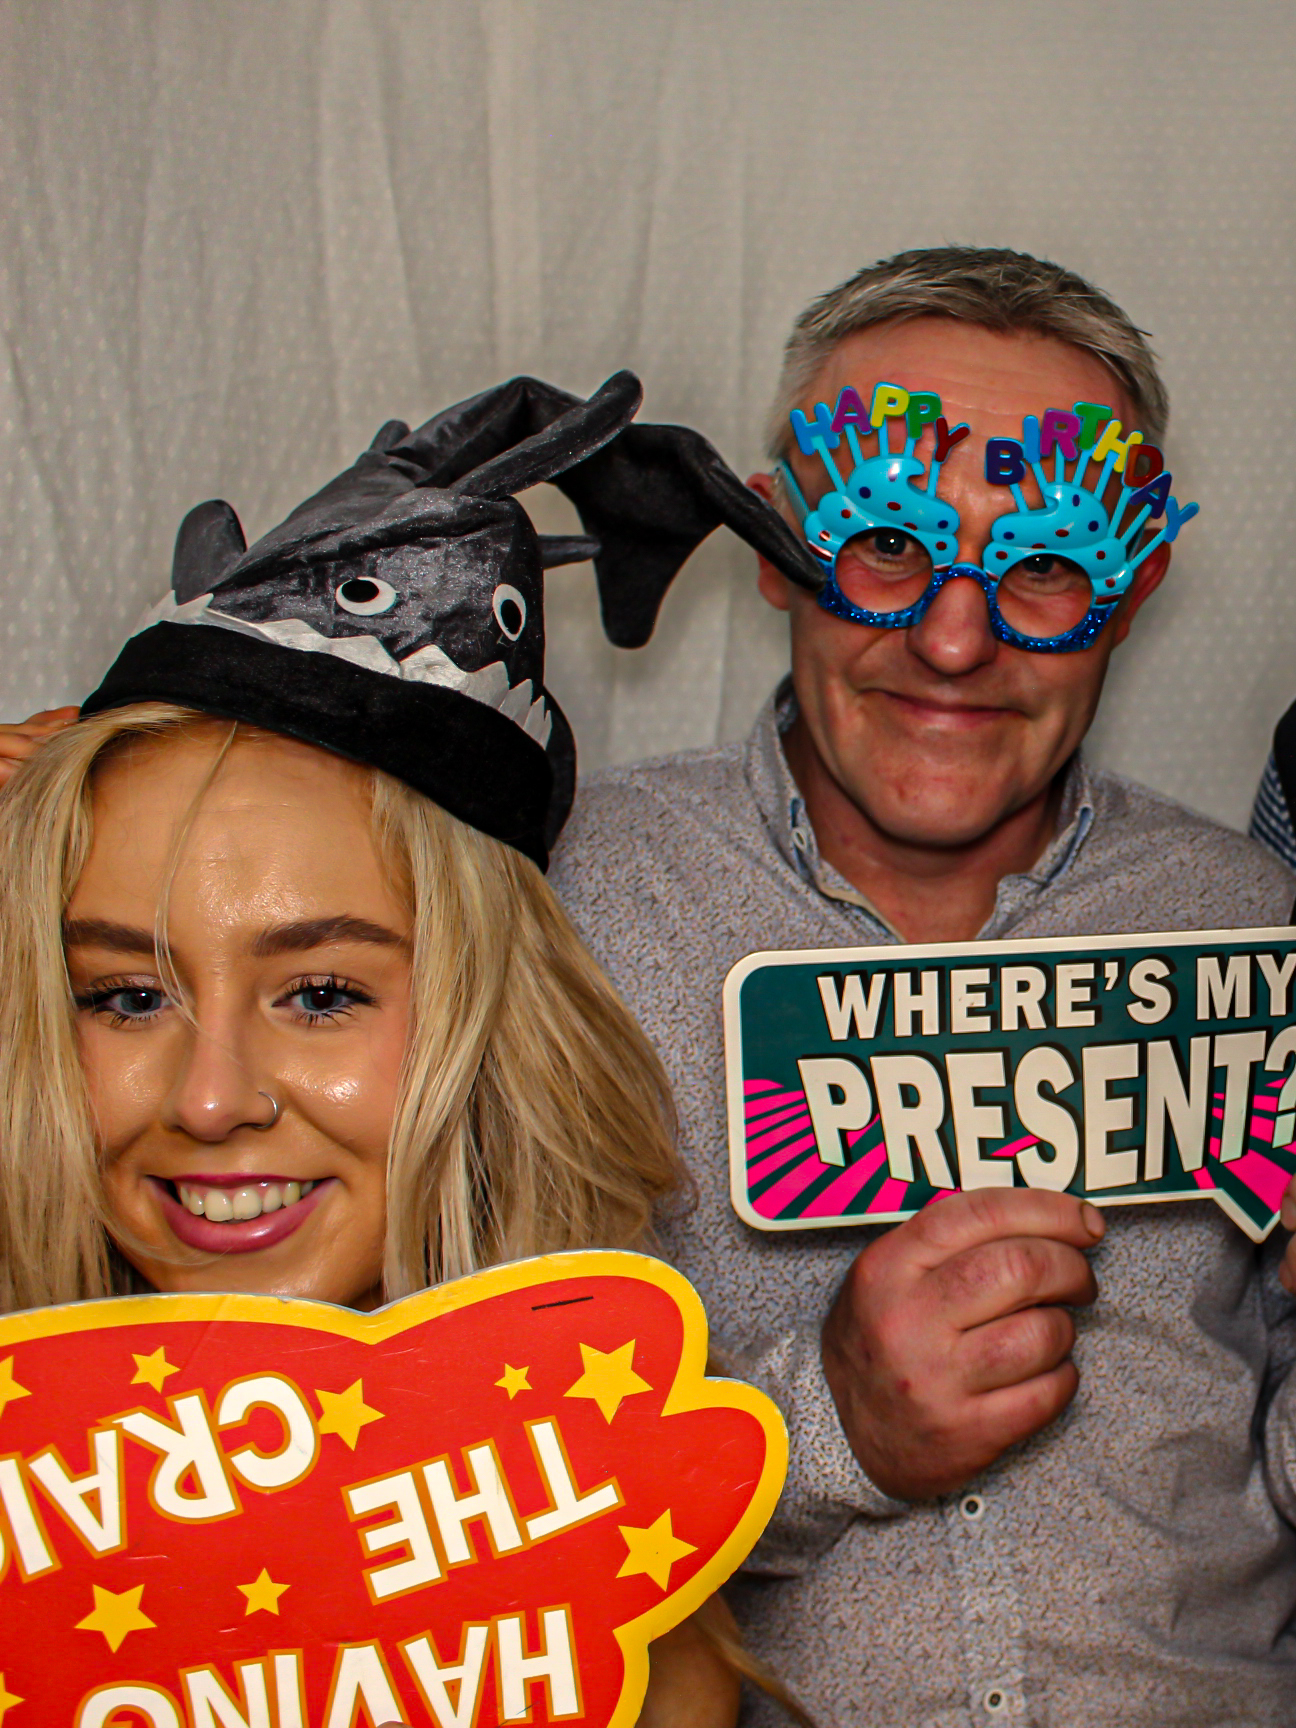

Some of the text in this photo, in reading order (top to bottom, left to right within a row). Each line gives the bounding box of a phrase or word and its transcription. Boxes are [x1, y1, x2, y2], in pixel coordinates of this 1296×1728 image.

[790, 381, 1199, 543] HAPPY BIRTHDAY
[815, 957, 1172, 1041] WHERE'S
[0, 1373, 318, 1580] CRAI
[346, 1418, 623, 1601] THE
